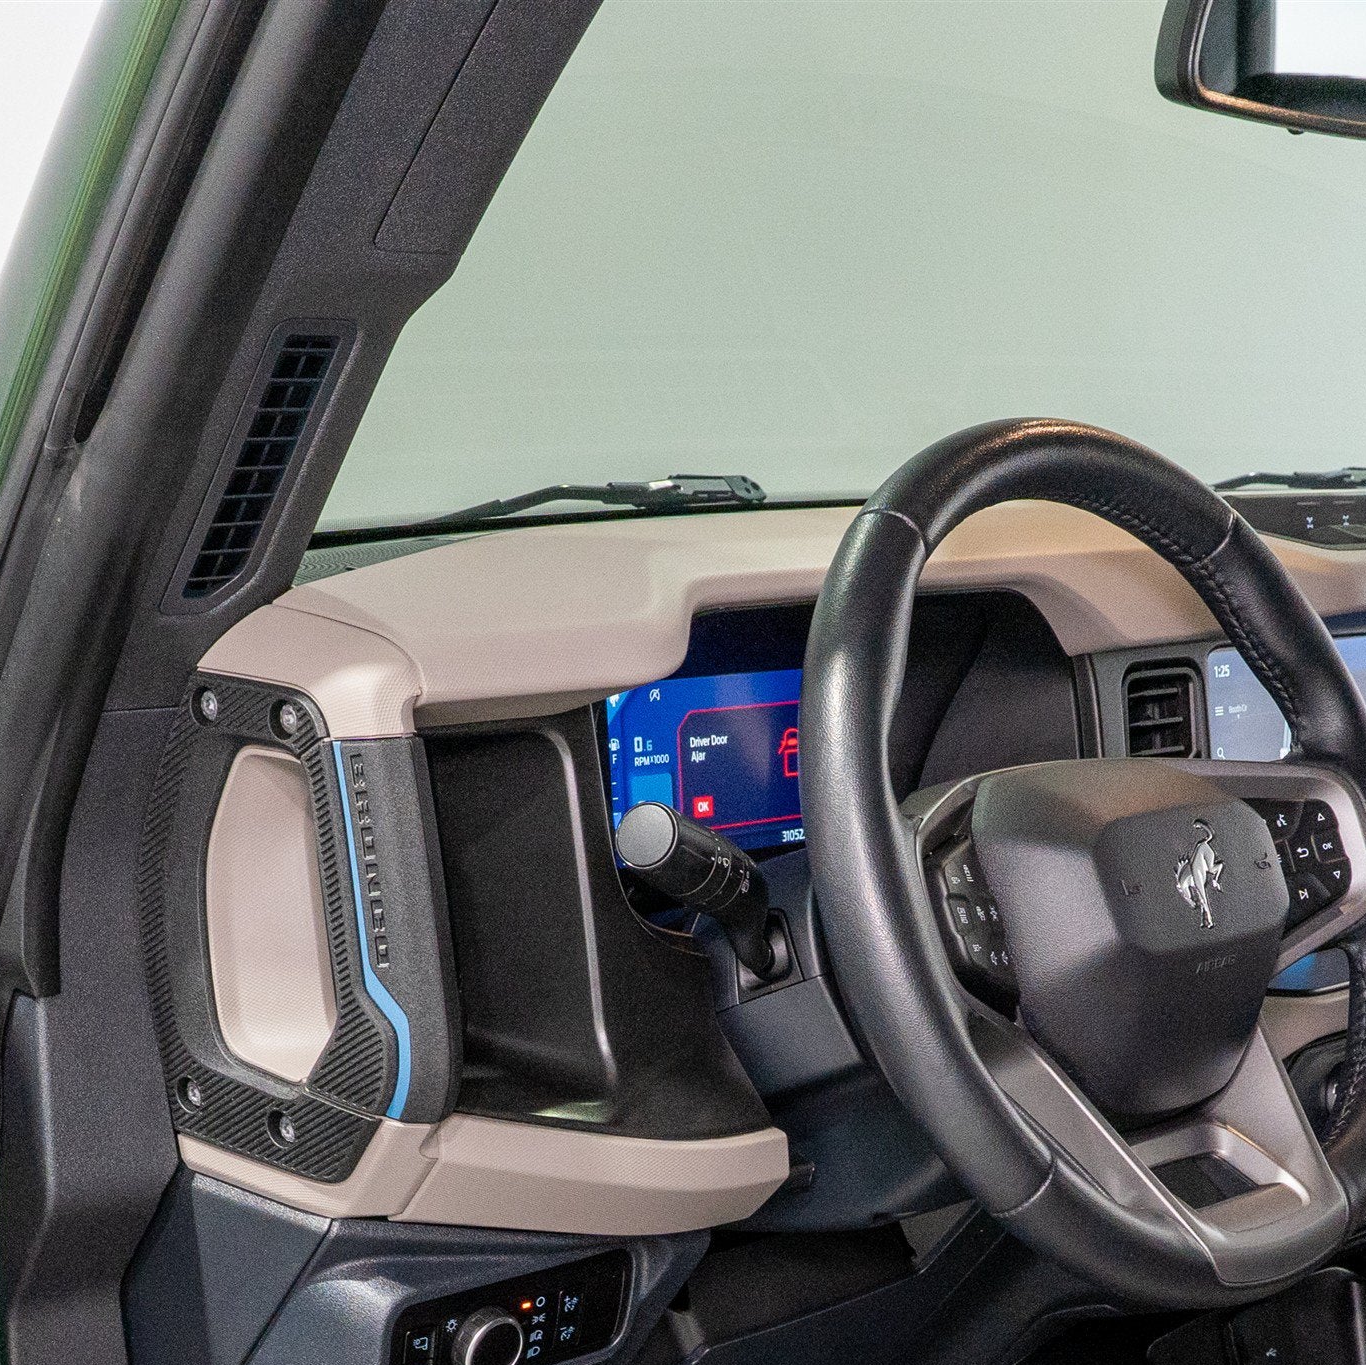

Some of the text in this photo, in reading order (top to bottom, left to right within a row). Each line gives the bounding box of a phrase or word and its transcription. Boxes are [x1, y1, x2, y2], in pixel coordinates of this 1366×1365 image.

[1213, 664, 1231, 678] 1:25
[689, 734, 728, 748] Driver Door
[691, 750, 707, 763] Ajar
[697, 801, 710, 813] OK
[1322, 842, 1333, 850] OK
[349, 753, 391, 969] BRONCO
